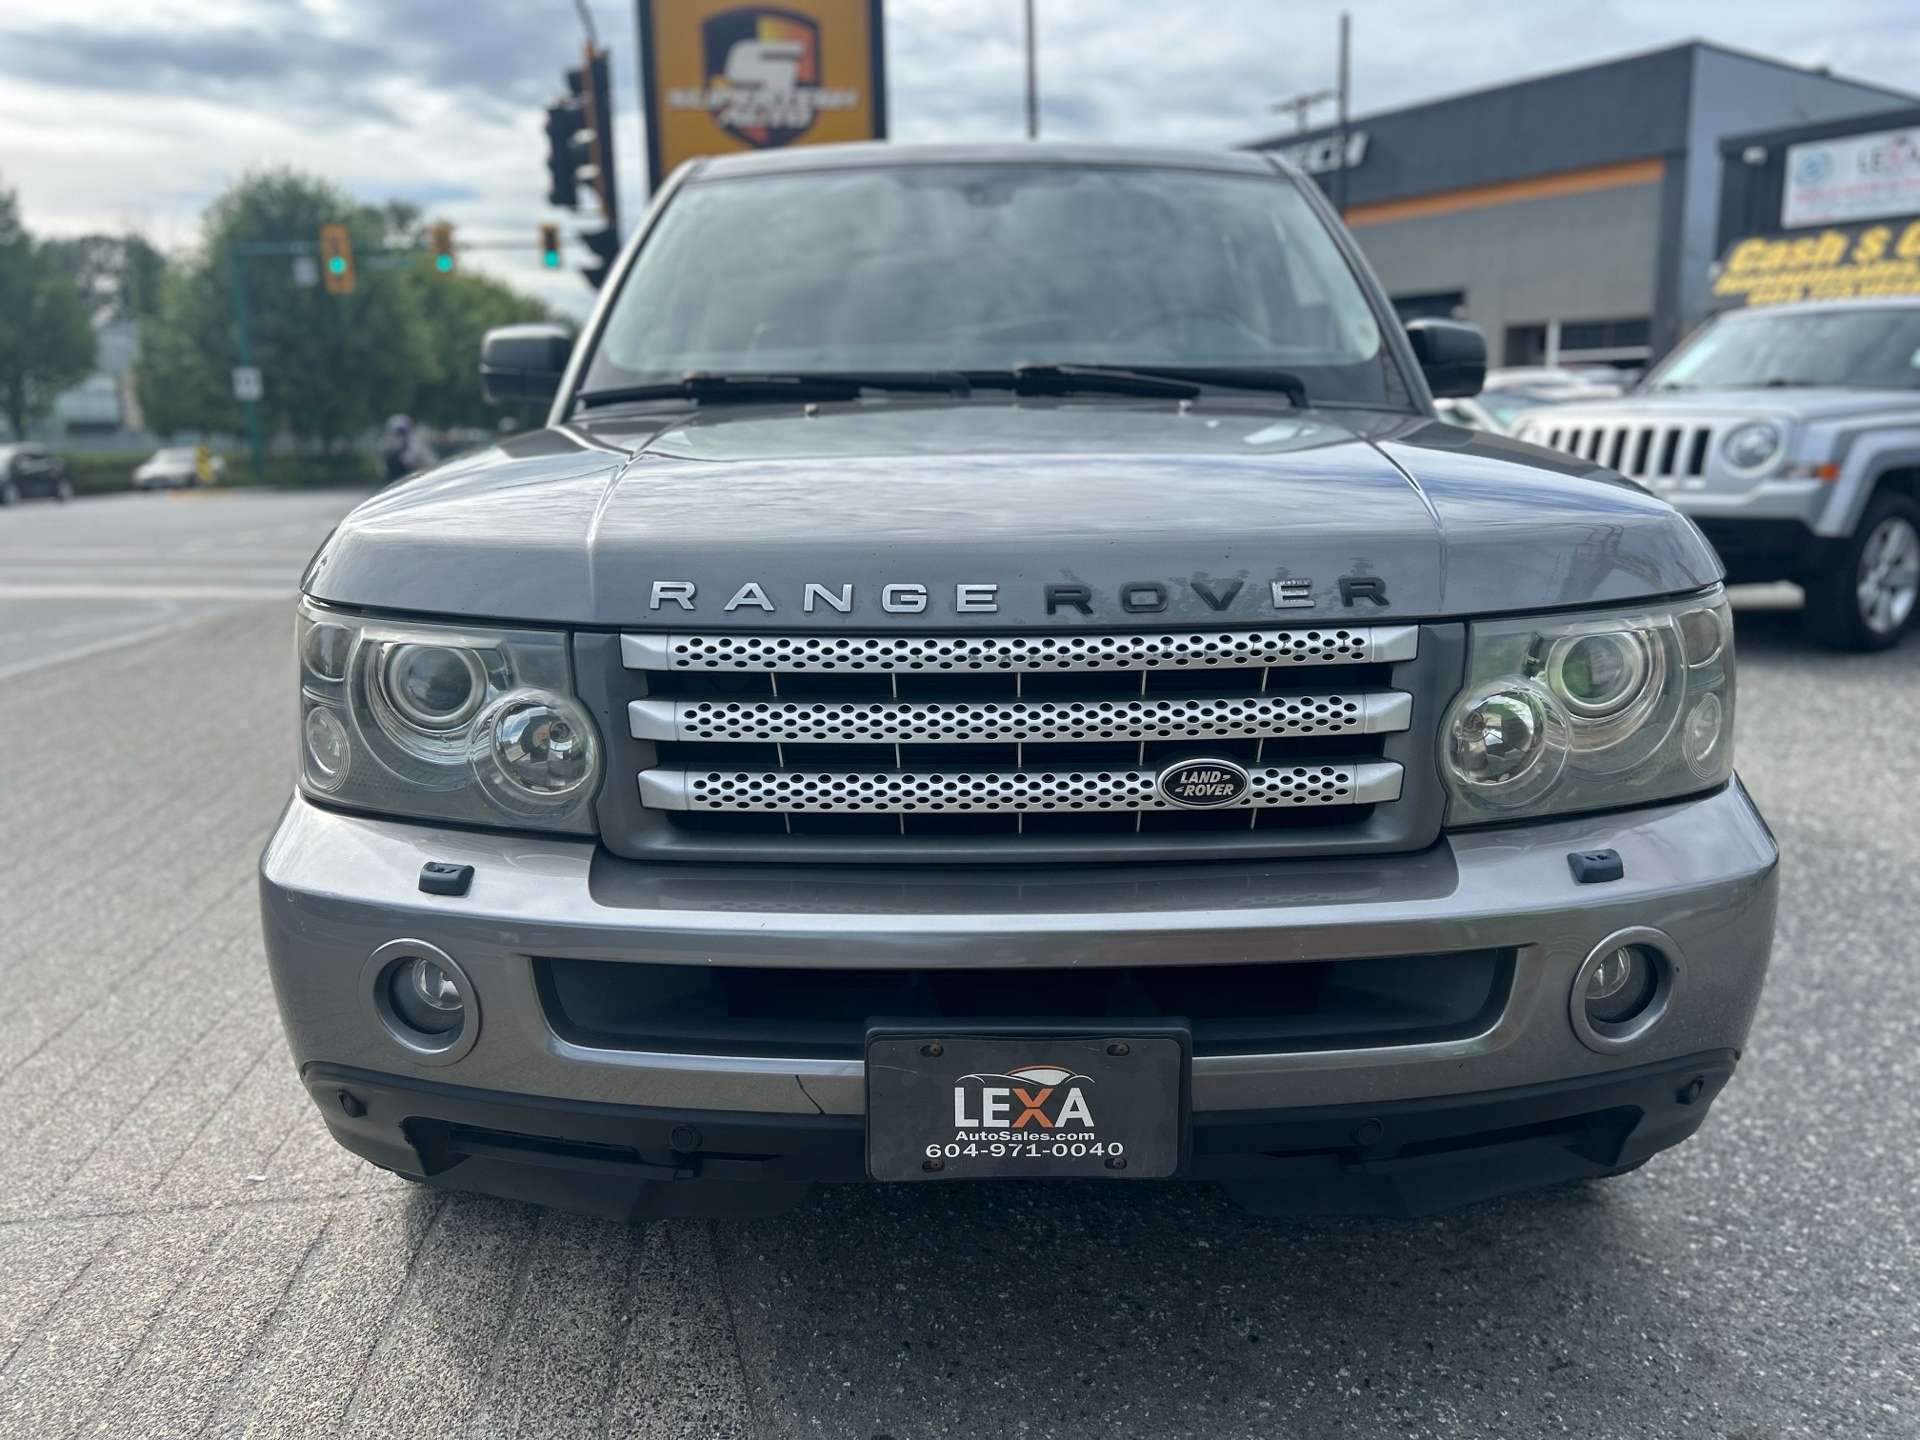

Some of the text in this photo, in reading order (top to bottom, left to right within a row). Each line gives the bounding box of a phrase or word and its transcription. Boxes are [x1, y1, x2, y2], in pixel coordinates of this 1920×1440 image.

[1727, 229, 1848, 272] Cash
[650, 575, 1391, 616] RANGE ROVER
[1180, 771, 1222, 784] LAND
[1183, 783, 1234, 797] ROVER
[954, 1086, 1095, 1128] LEXA
[955, 1130, 1096, 1142] AutoSales.com
[925, 1142, 1124, 1158] 604-971-0040
